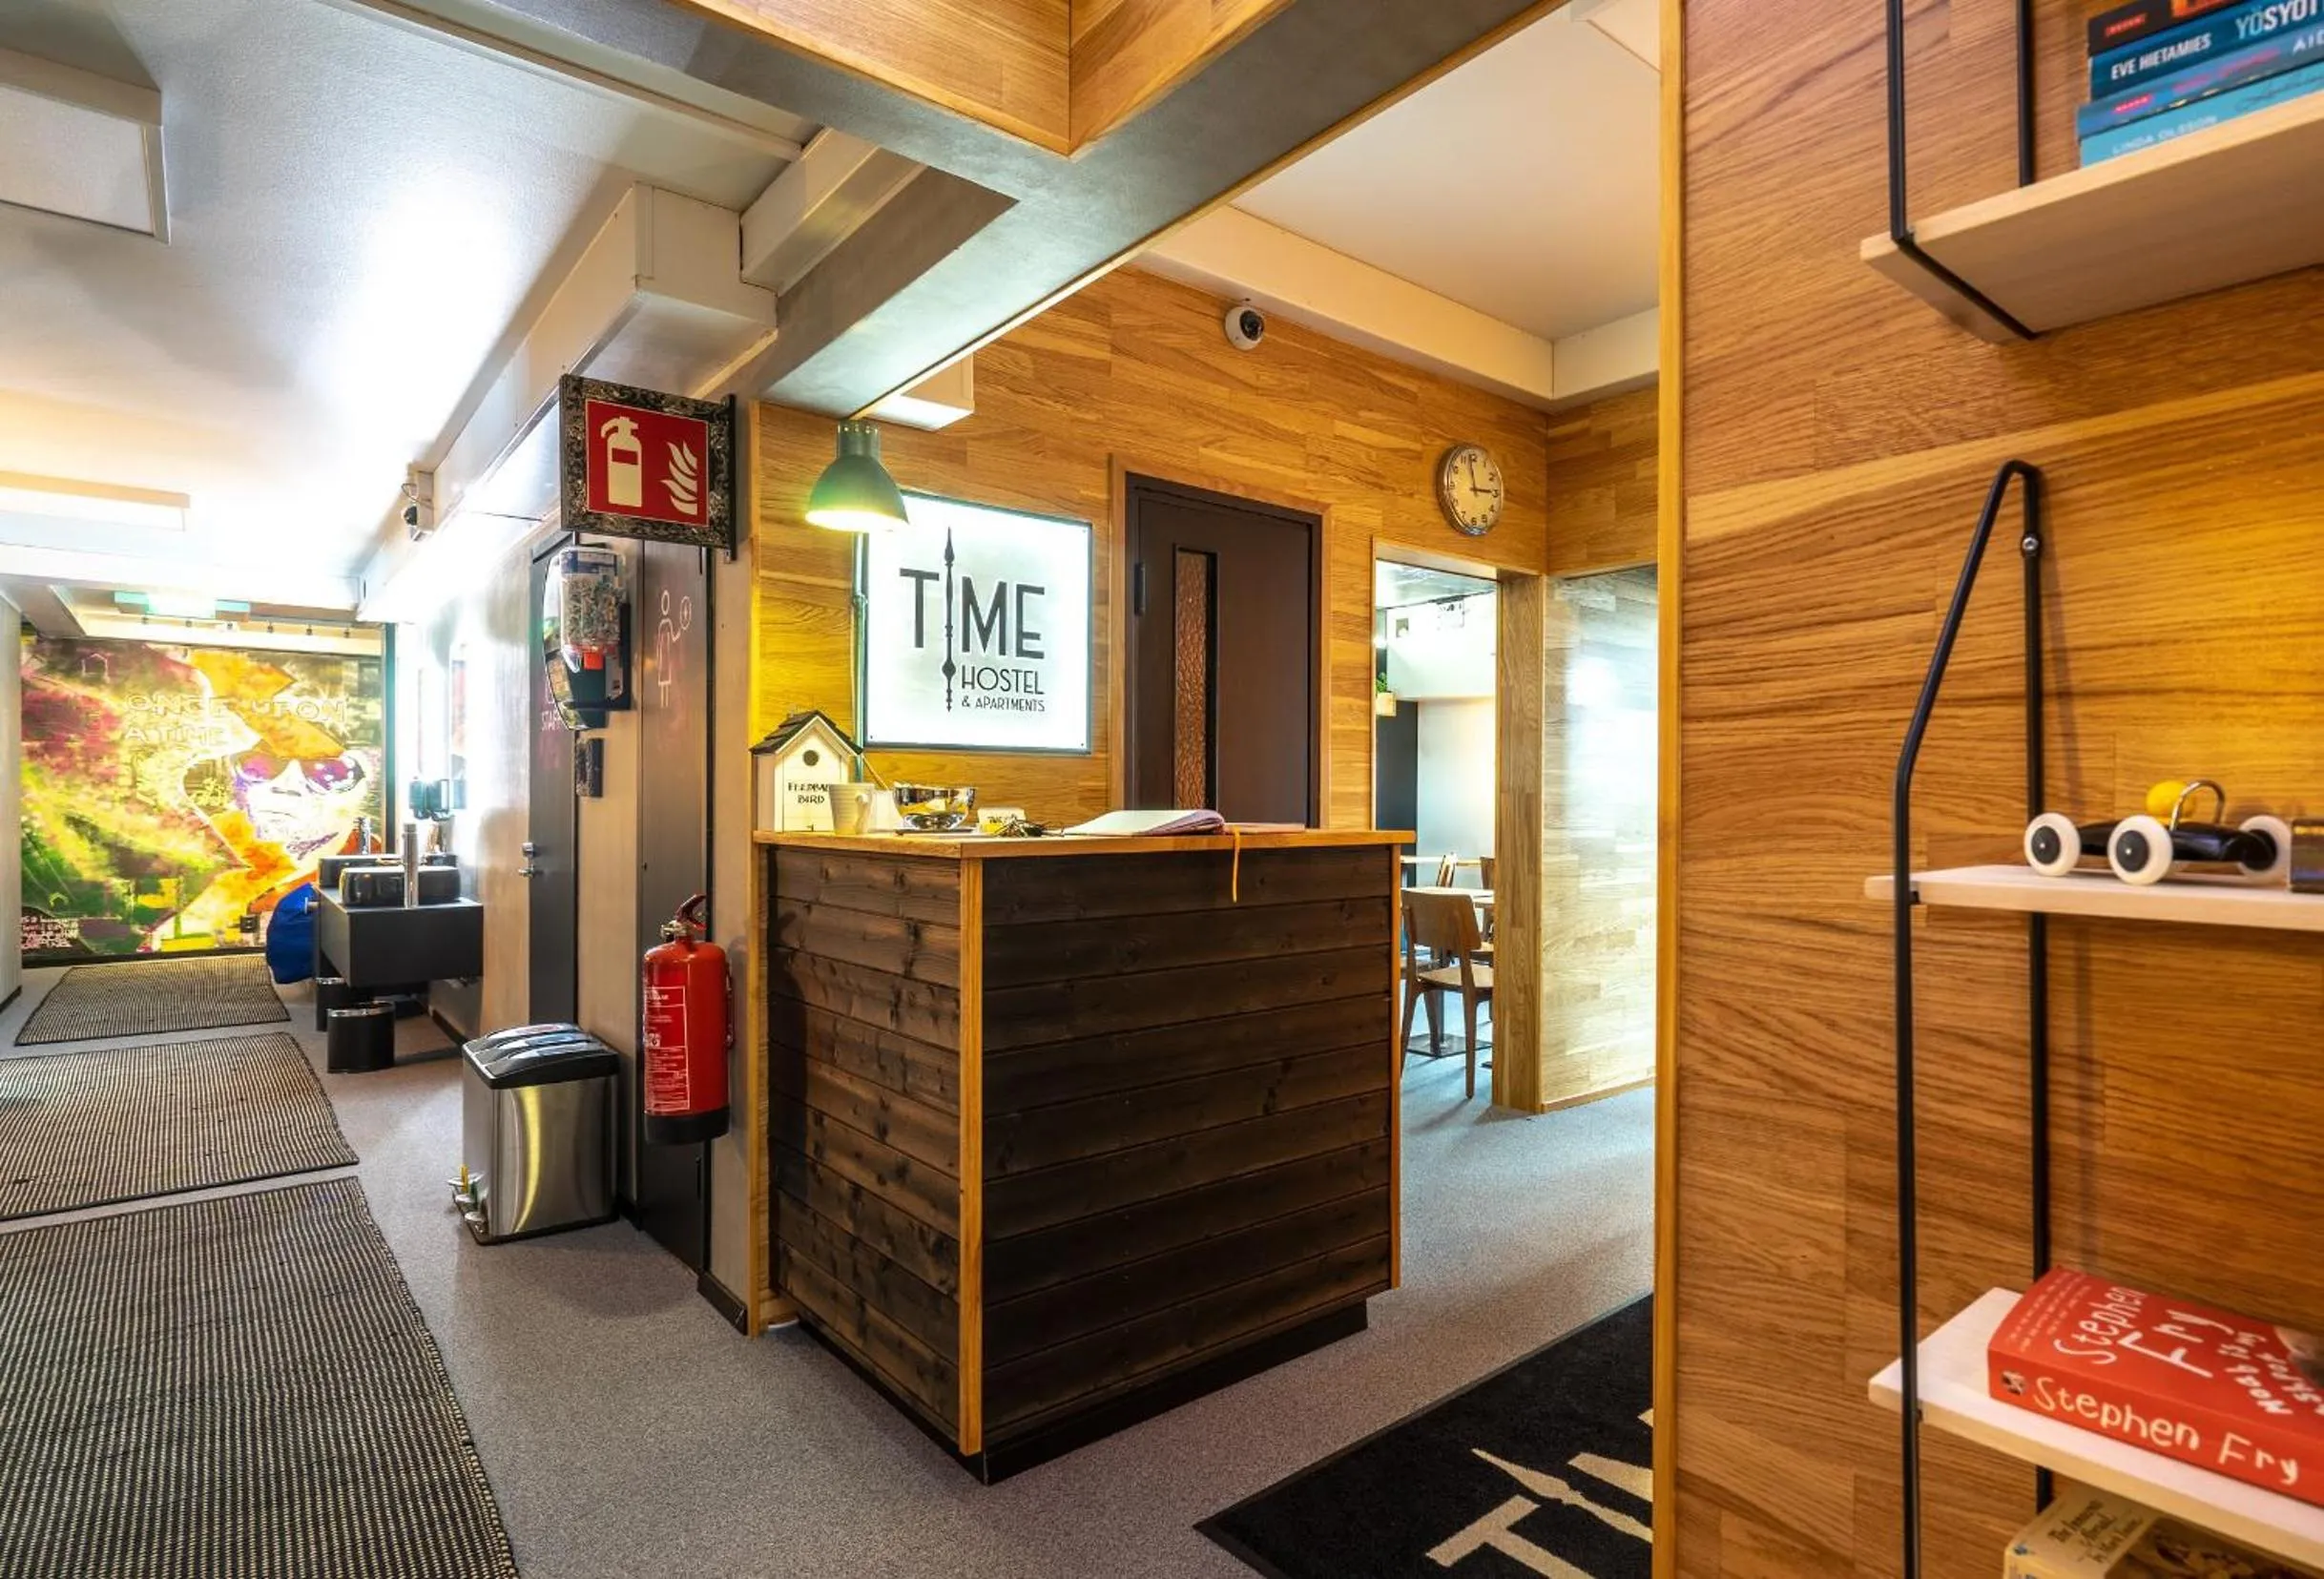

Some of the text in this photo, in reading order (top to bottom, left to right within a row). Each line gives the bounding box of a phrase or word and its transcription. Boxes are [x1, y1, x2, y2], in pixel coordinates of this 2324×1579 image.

[2111, 56, 2135, 80] EVE
[2139, 32, 2211, 71] HIETAMIES
[962, 665, 1045, 695] HOSTEL
[962, 696, 1046, 712] & APARTMENTS
[798, 794, 825, 803] BIRD
[2053, 1287, 2148, 1364] Stephen
[2116, 1309, 2234, 1378] Fry
[2033, 1377, 2299, 1486] Stephen Fry
